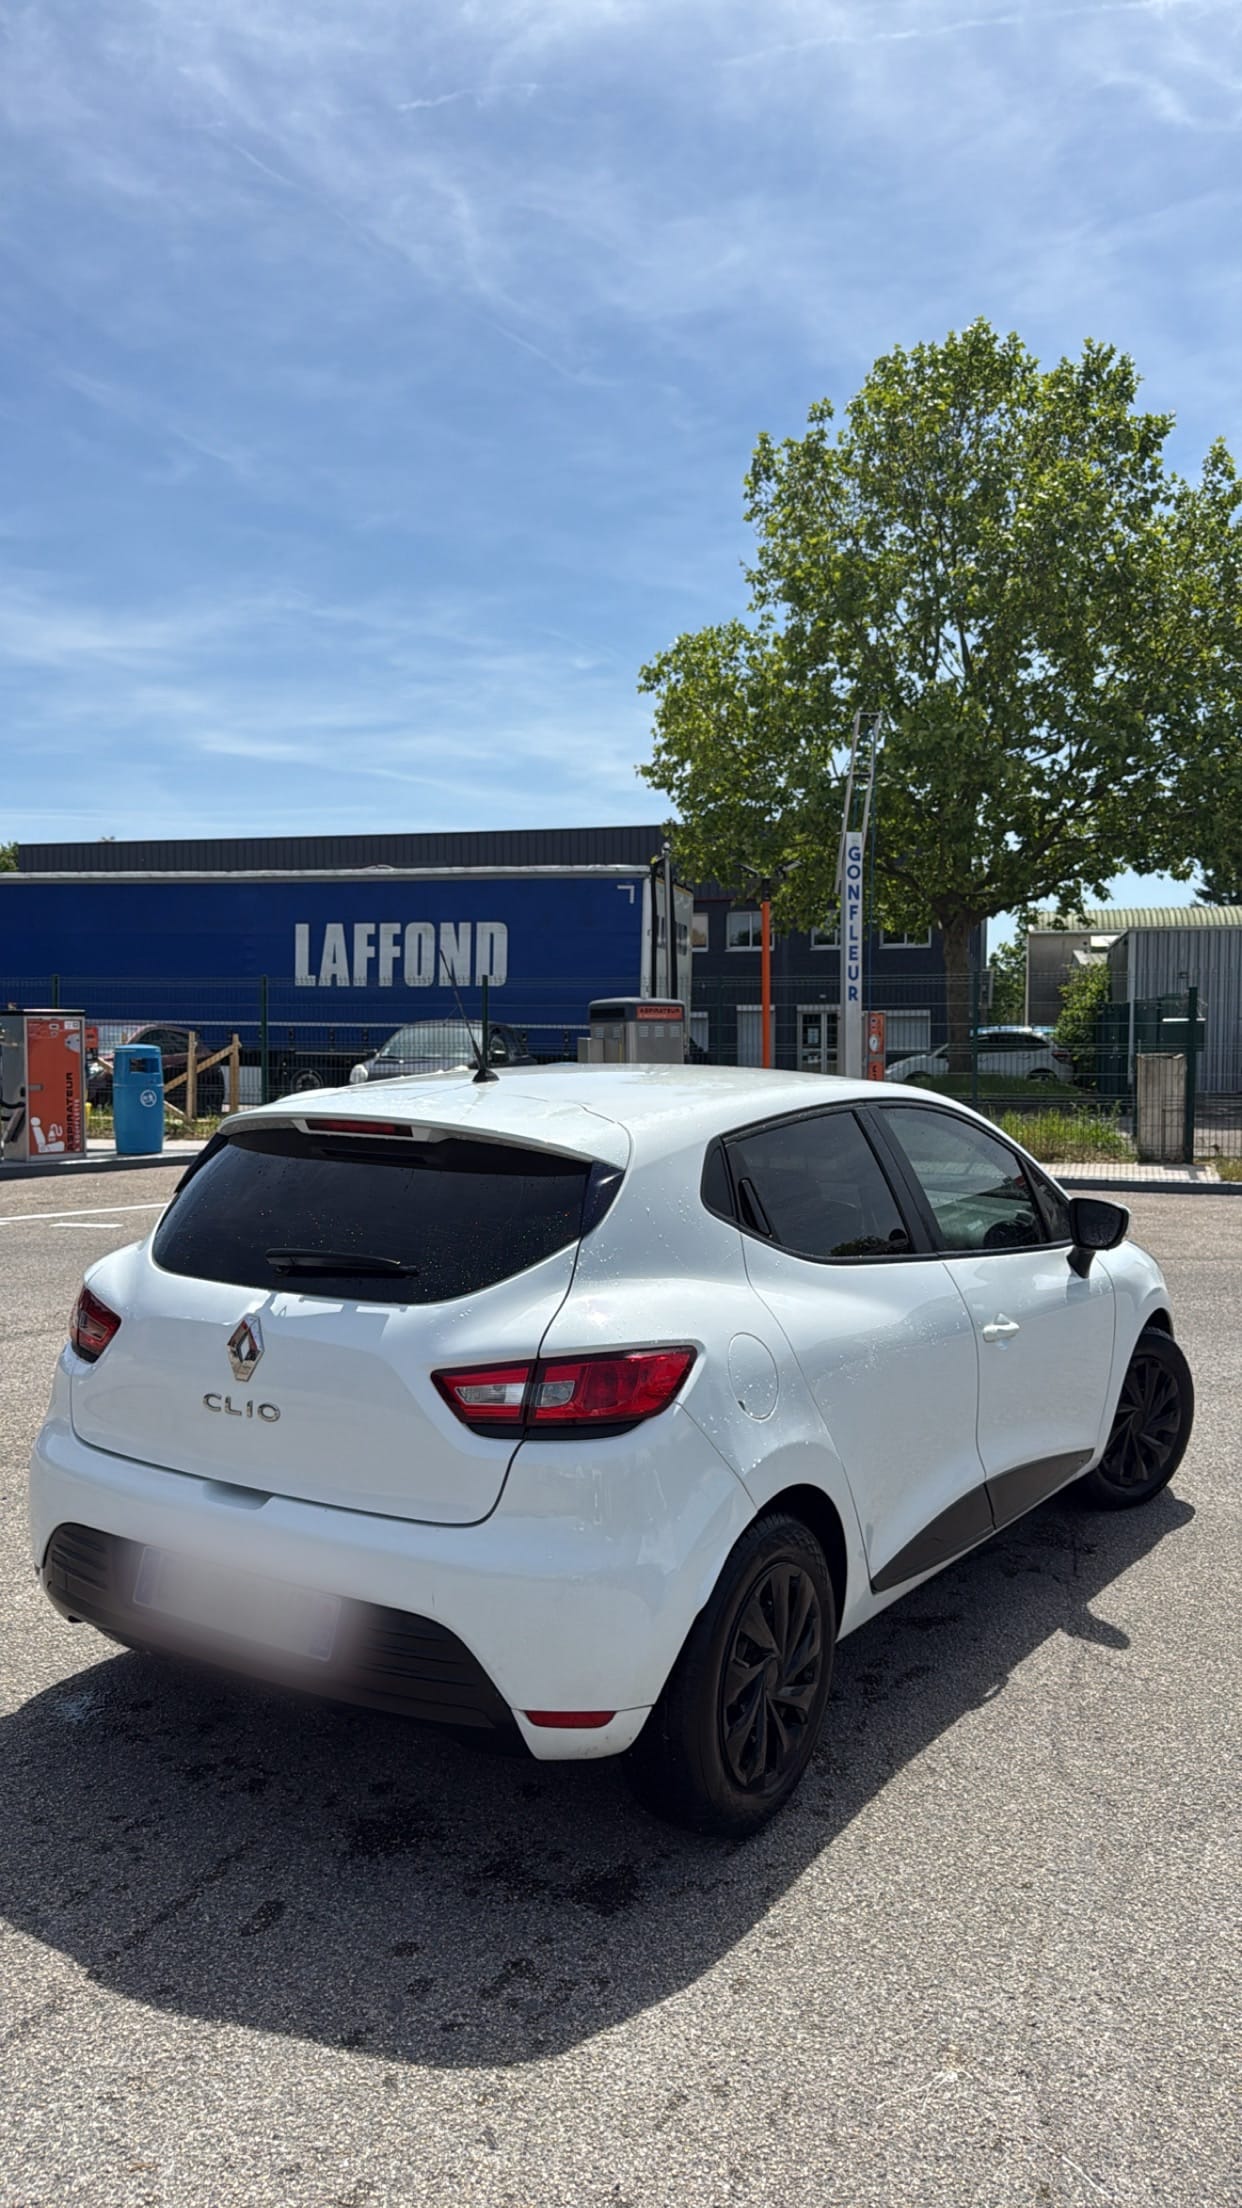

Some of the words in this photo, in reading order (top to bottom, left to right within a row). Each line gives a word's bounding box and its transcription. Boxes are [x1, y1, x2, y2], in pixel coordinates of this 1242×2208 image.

[295, 922, 508, 987] LAFFOND
[847, 846, 860, 1001] GONFLEUR
[203, 1393, 281, 1423] CLIO
